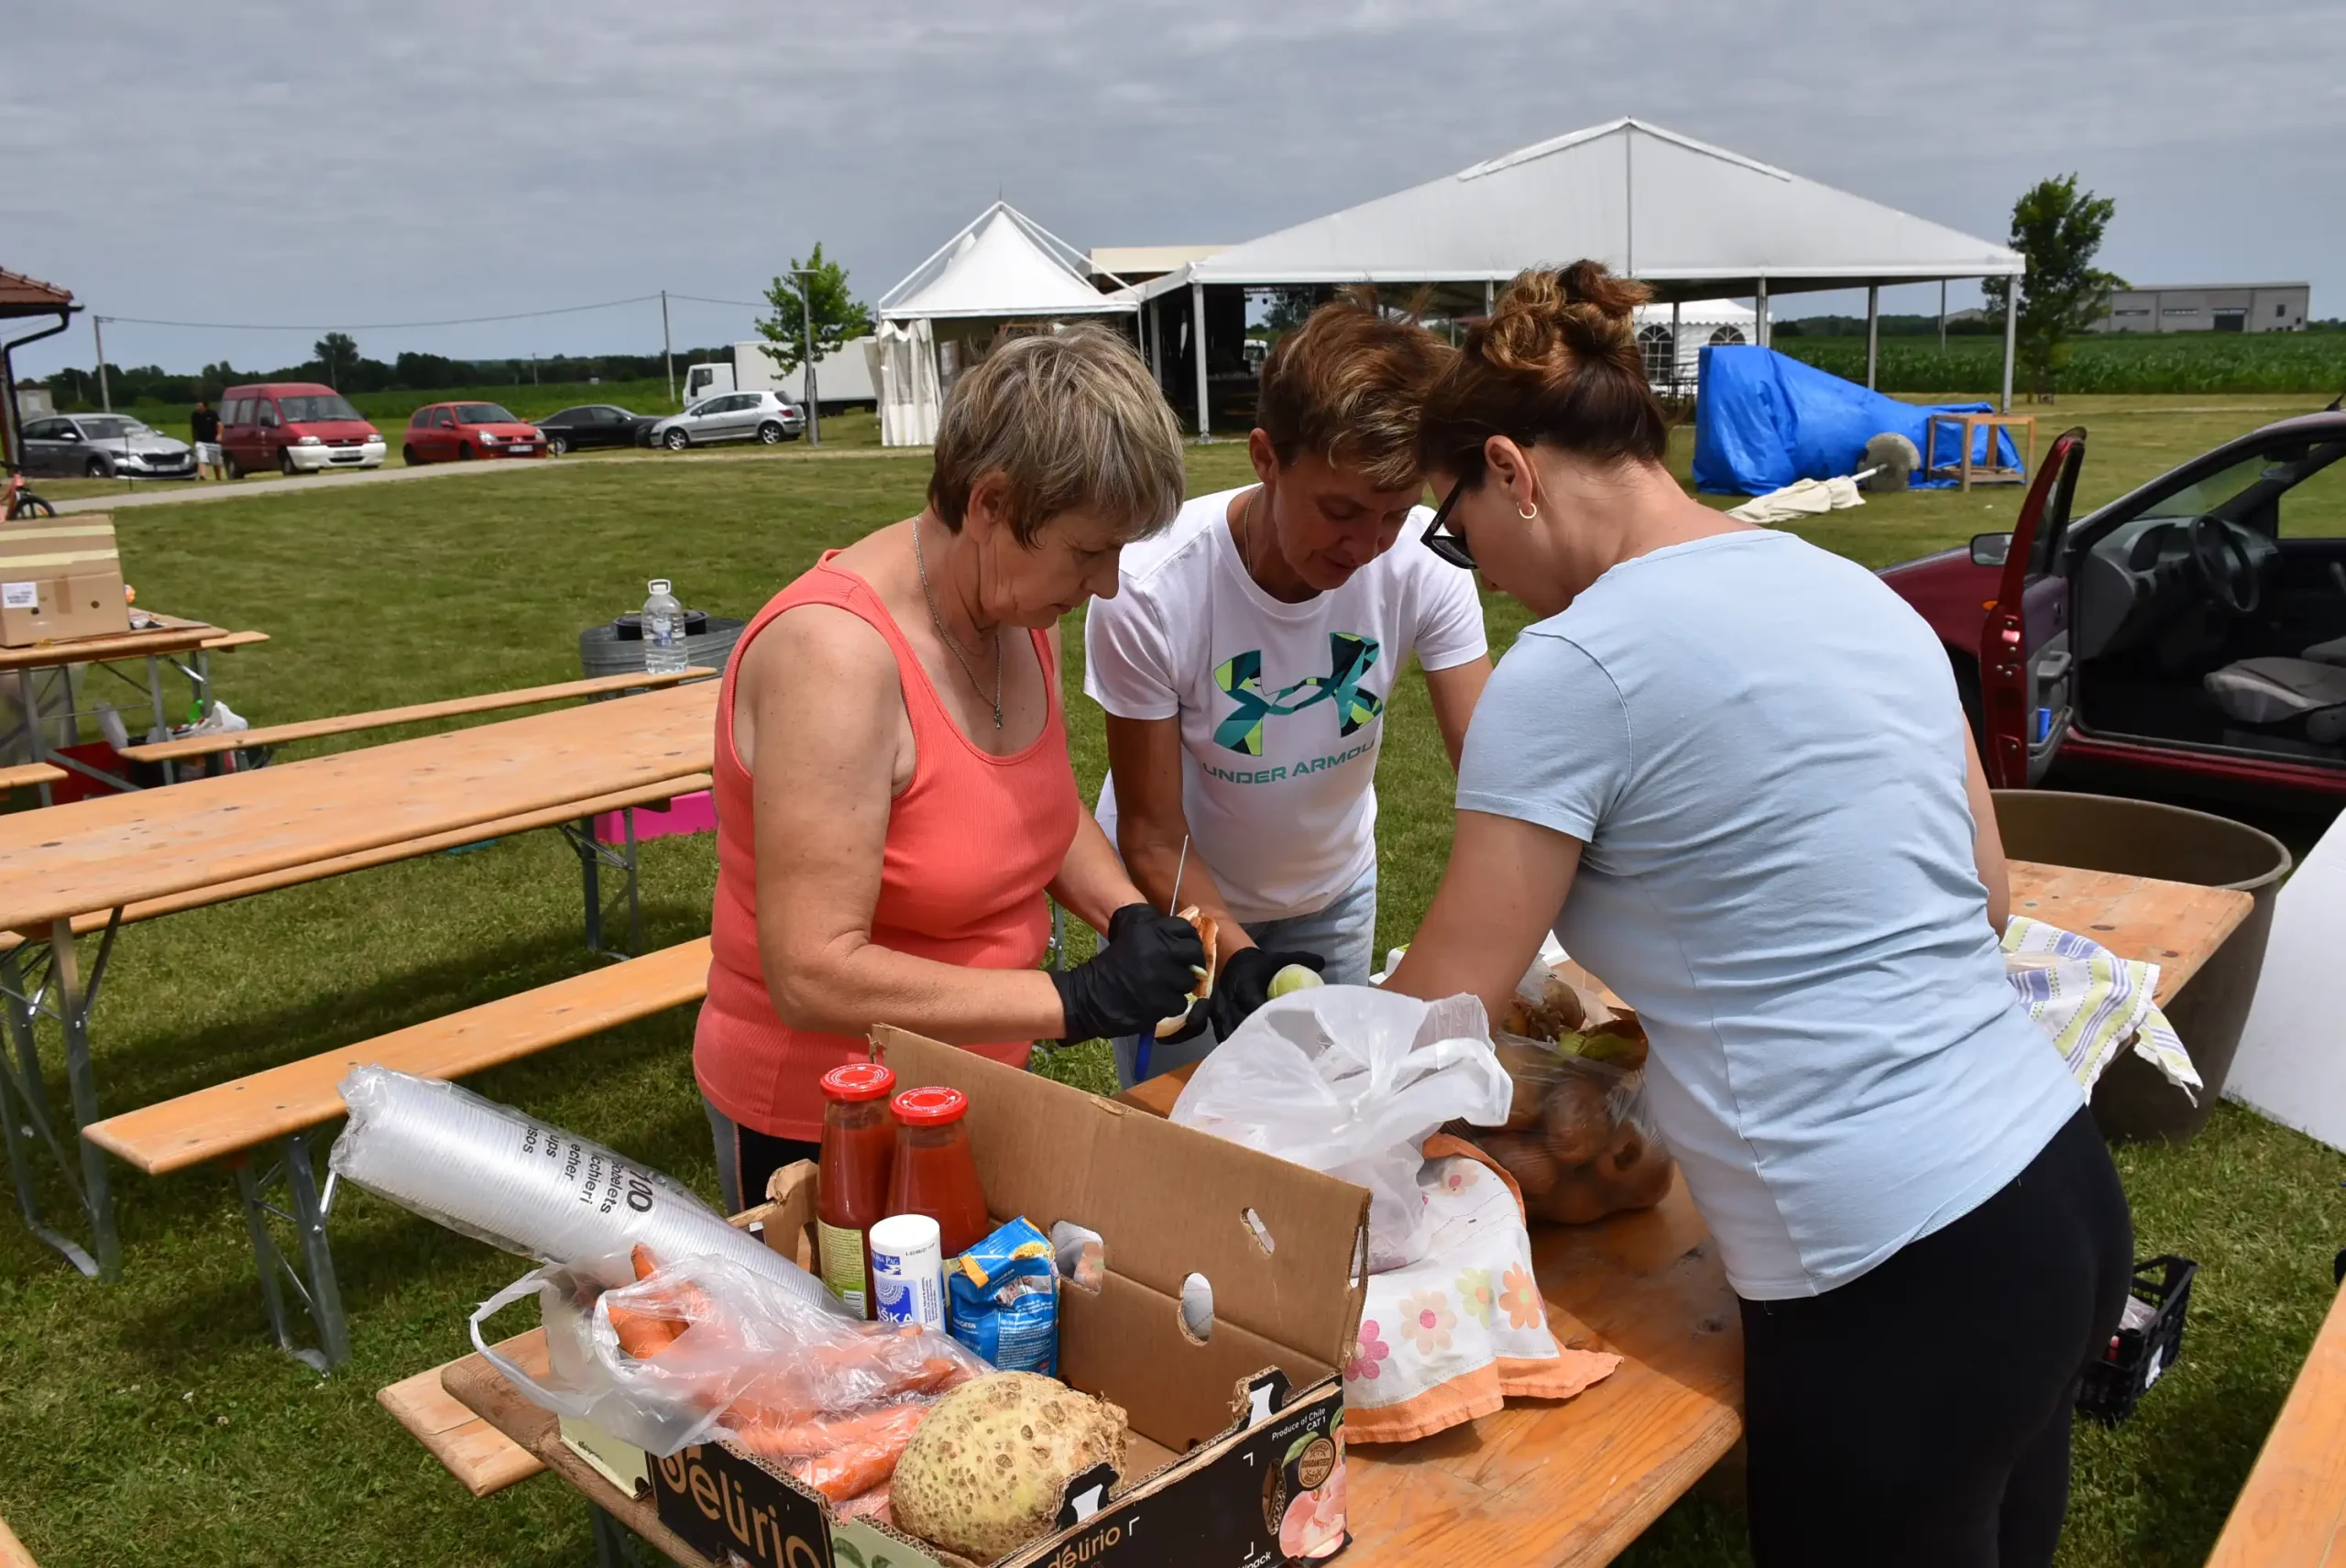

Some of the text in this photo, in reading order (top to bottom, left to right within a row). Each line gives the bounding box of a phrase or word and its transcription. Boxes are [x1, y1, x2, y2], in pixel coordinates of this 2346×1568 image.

[1203, 739, 1376, 784] UNDER ARMOU
[523, 1126, 539, 1154] sos
[545, 1135, 560, 1158] ups
[565, 1143, 581, 1181] echer
[579, 1153, 604, 1204] icchieri
[627, 1170, 653, 1212] 100
[877, 1305, 915, 1325] AŠKA
[1271, 1408, 1326, 1442] Produce of Chile
[1306, 1419, 1321, 1431] CAT
